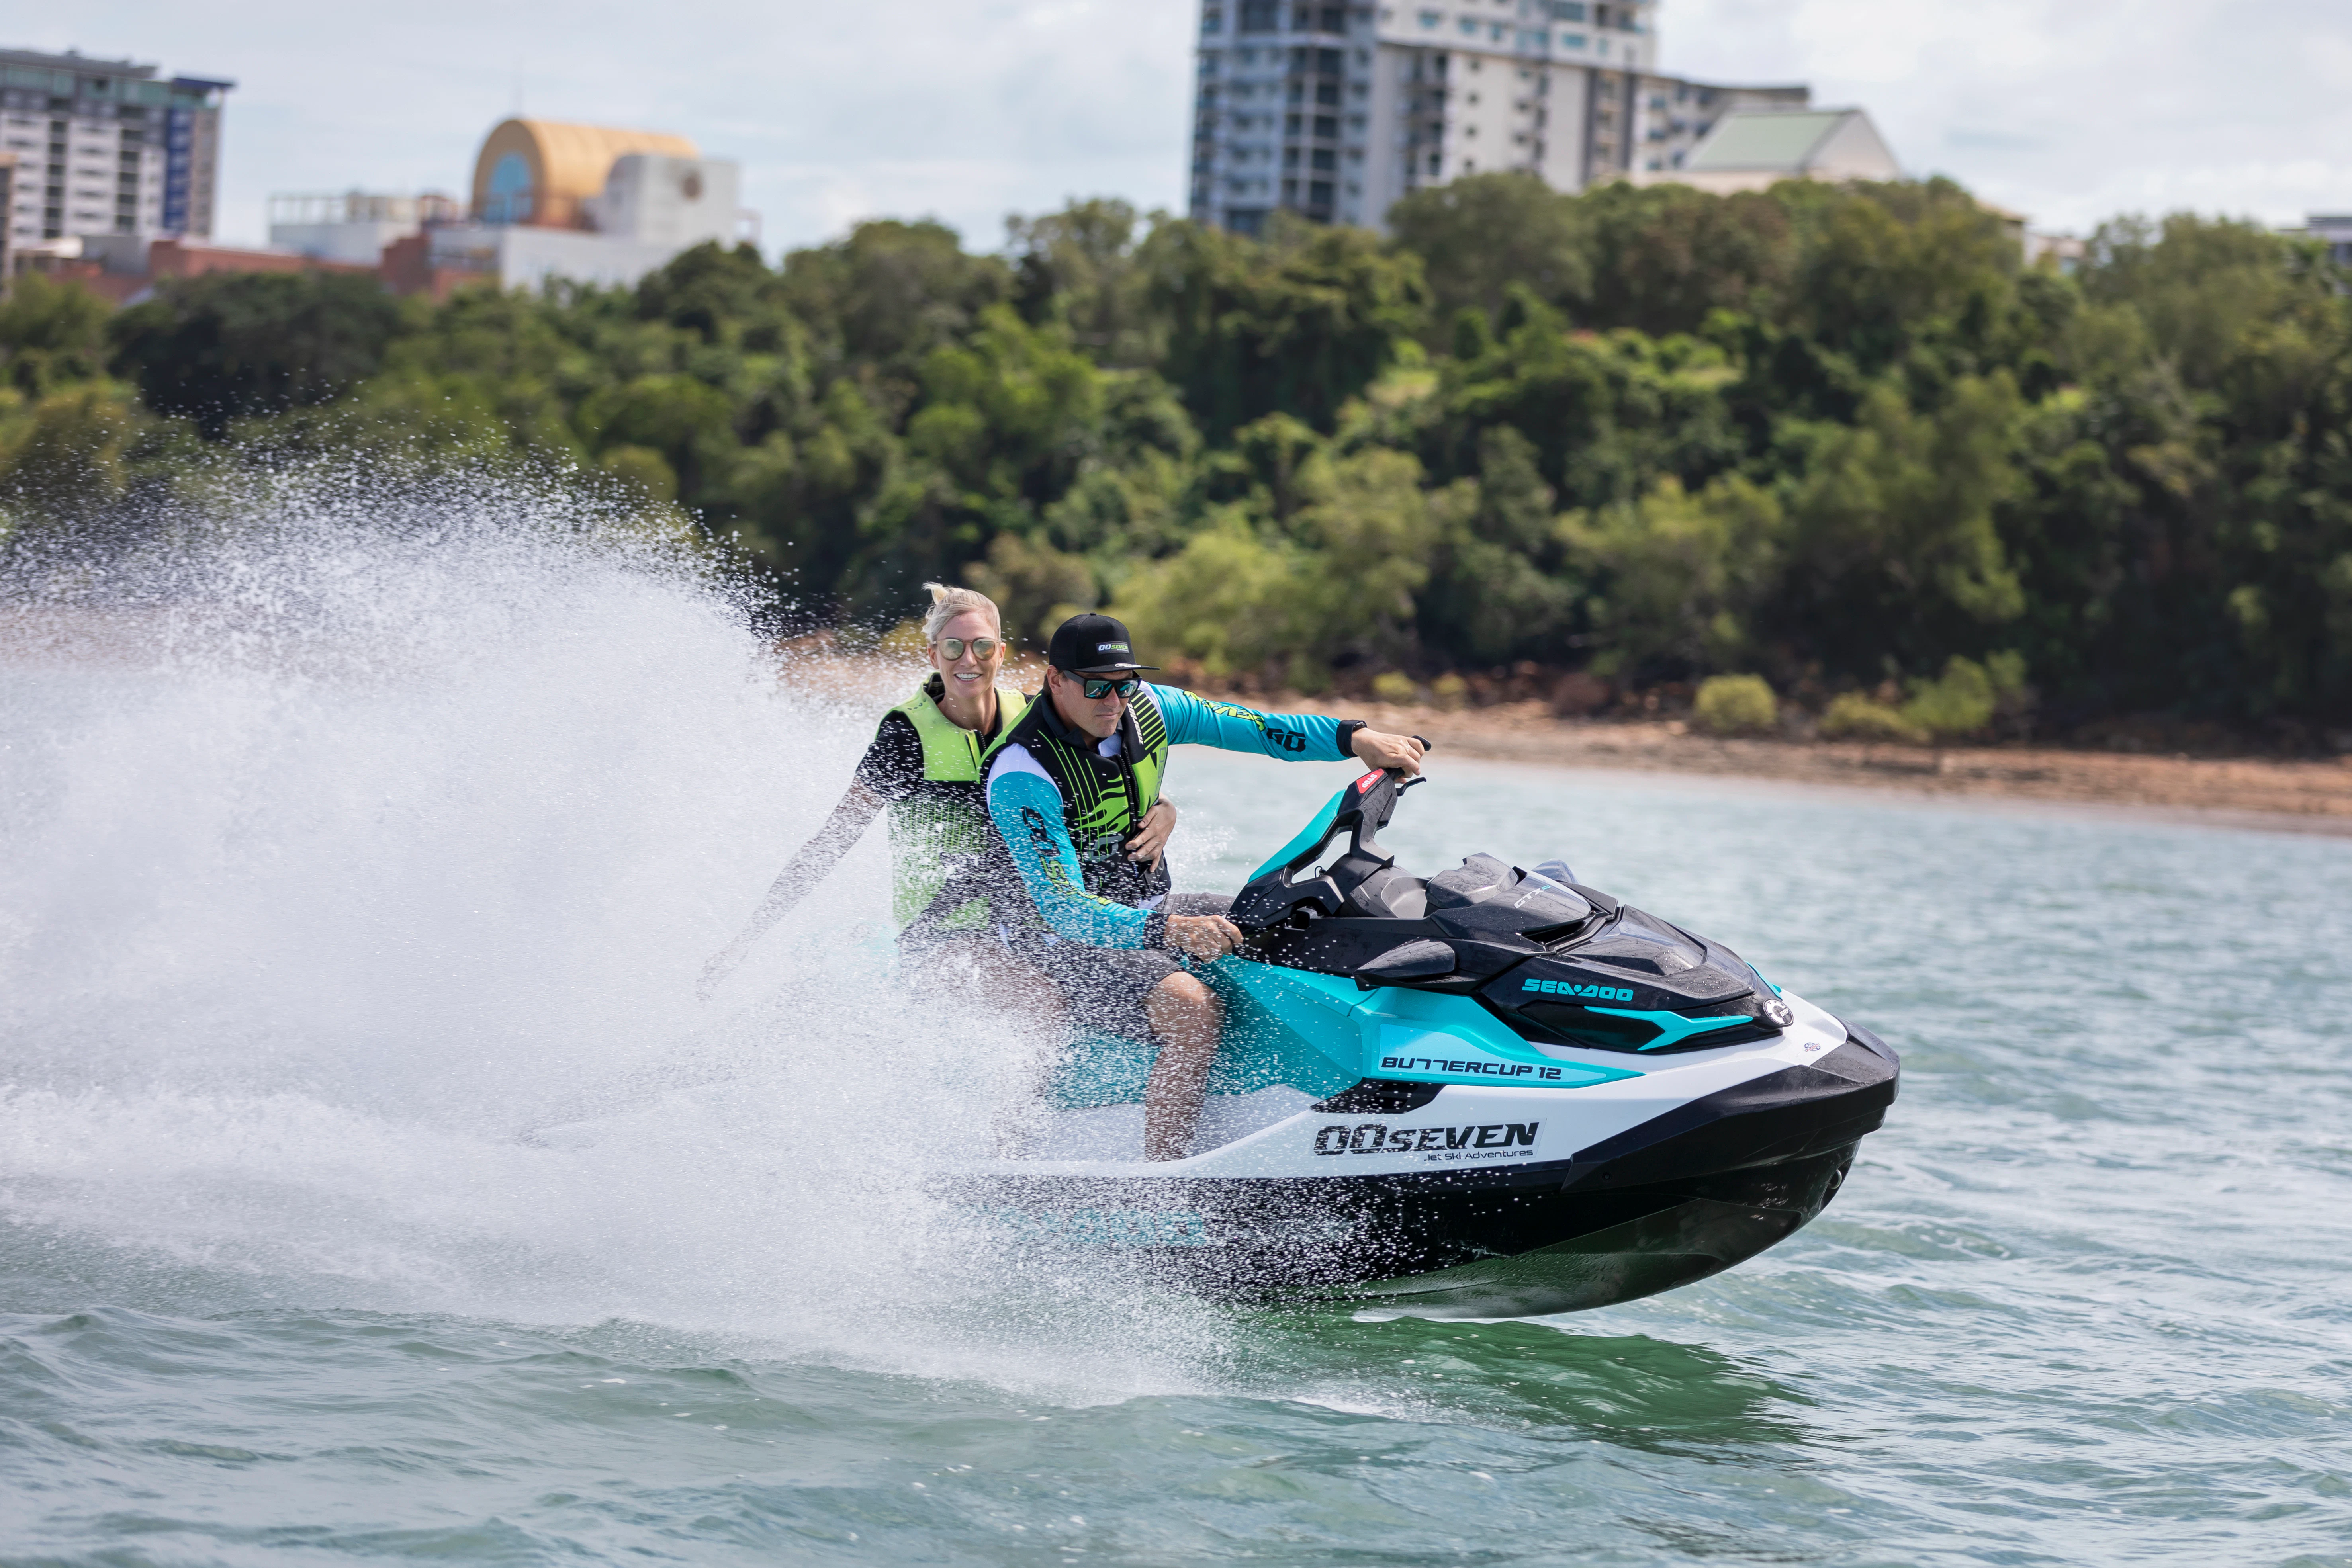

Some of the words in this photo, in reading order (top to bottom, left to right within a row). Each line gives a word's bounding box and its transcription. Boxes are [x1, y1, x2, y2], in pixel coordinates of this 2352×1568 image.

[1361, 774, 1378, 788] STOP
[1514, 888, 1545, 909] GTX
[1779, 1008, 1789, 1017] BRP
[1381, 1057, 1533, 1077] BUTTERCUP
[1538, 1067, 1562, 1080] 12
[1445, 1152, 1461, 1160] Ski
[1465, 1150, 1533, 1159] Adventures
